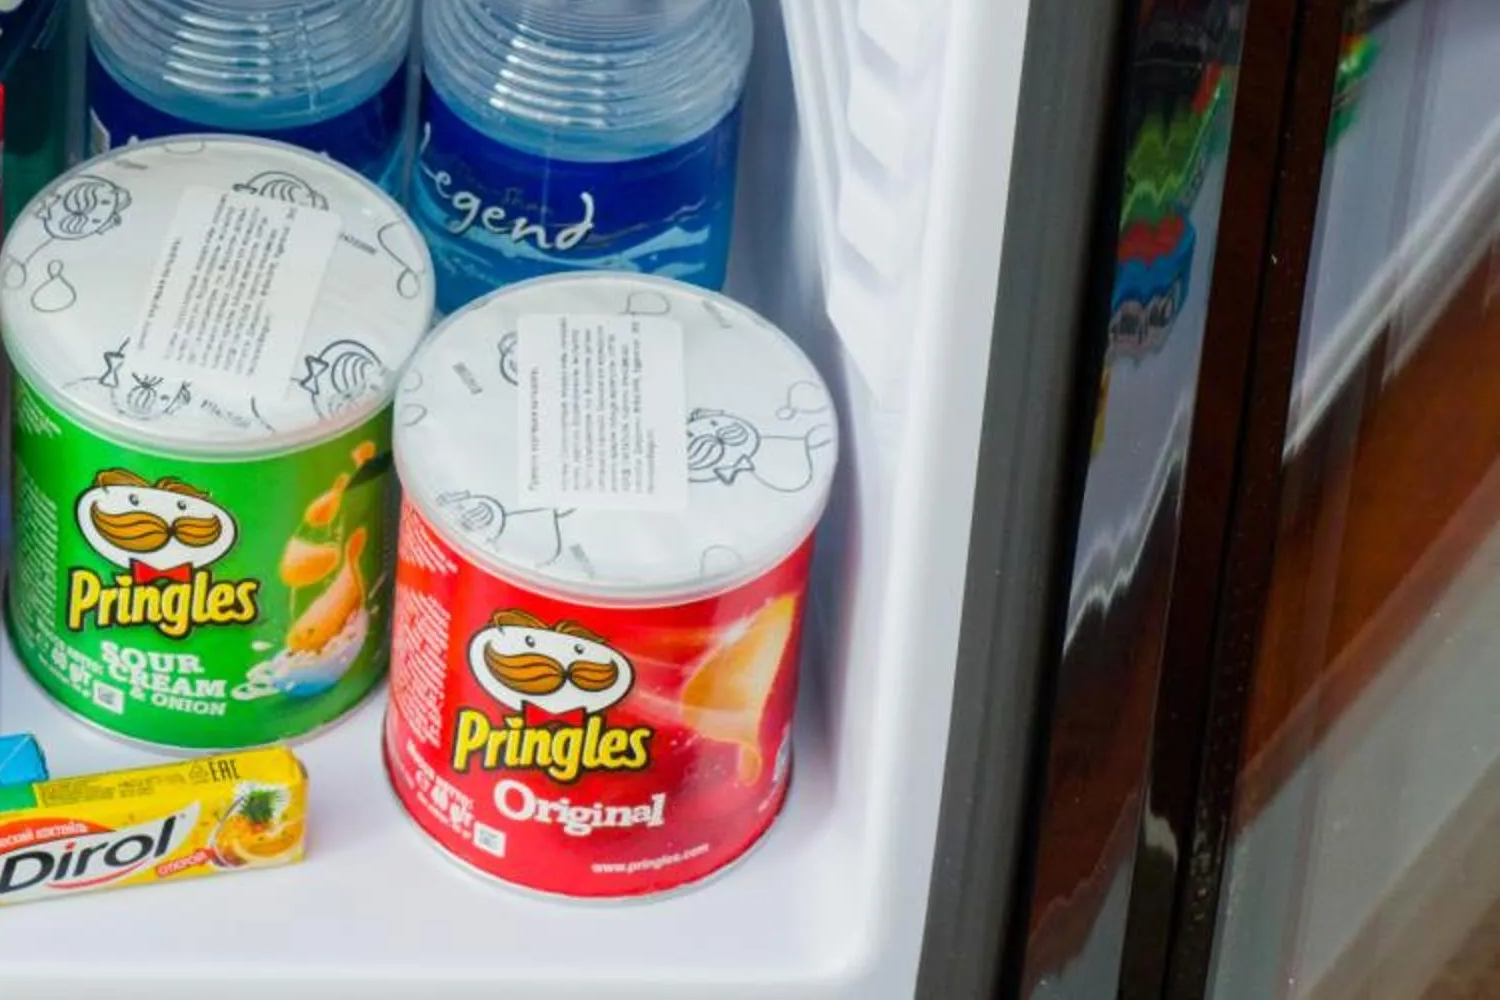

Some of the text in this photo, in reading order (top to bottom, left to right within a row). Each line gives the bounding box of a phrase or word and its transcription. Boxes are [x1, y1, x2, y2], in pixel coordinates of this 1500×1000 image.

[67, 566, 261, 639] Pringles
[100, 640, 206, 675] SOUR
[108, 662, 229, 699] CREAM
[151, 692, 229, 717] ONION
[452, 708, 654, 784] Pringles
[493, 779, 667, 837] Original
[592, 844, 709, 875] www.pringles.com
